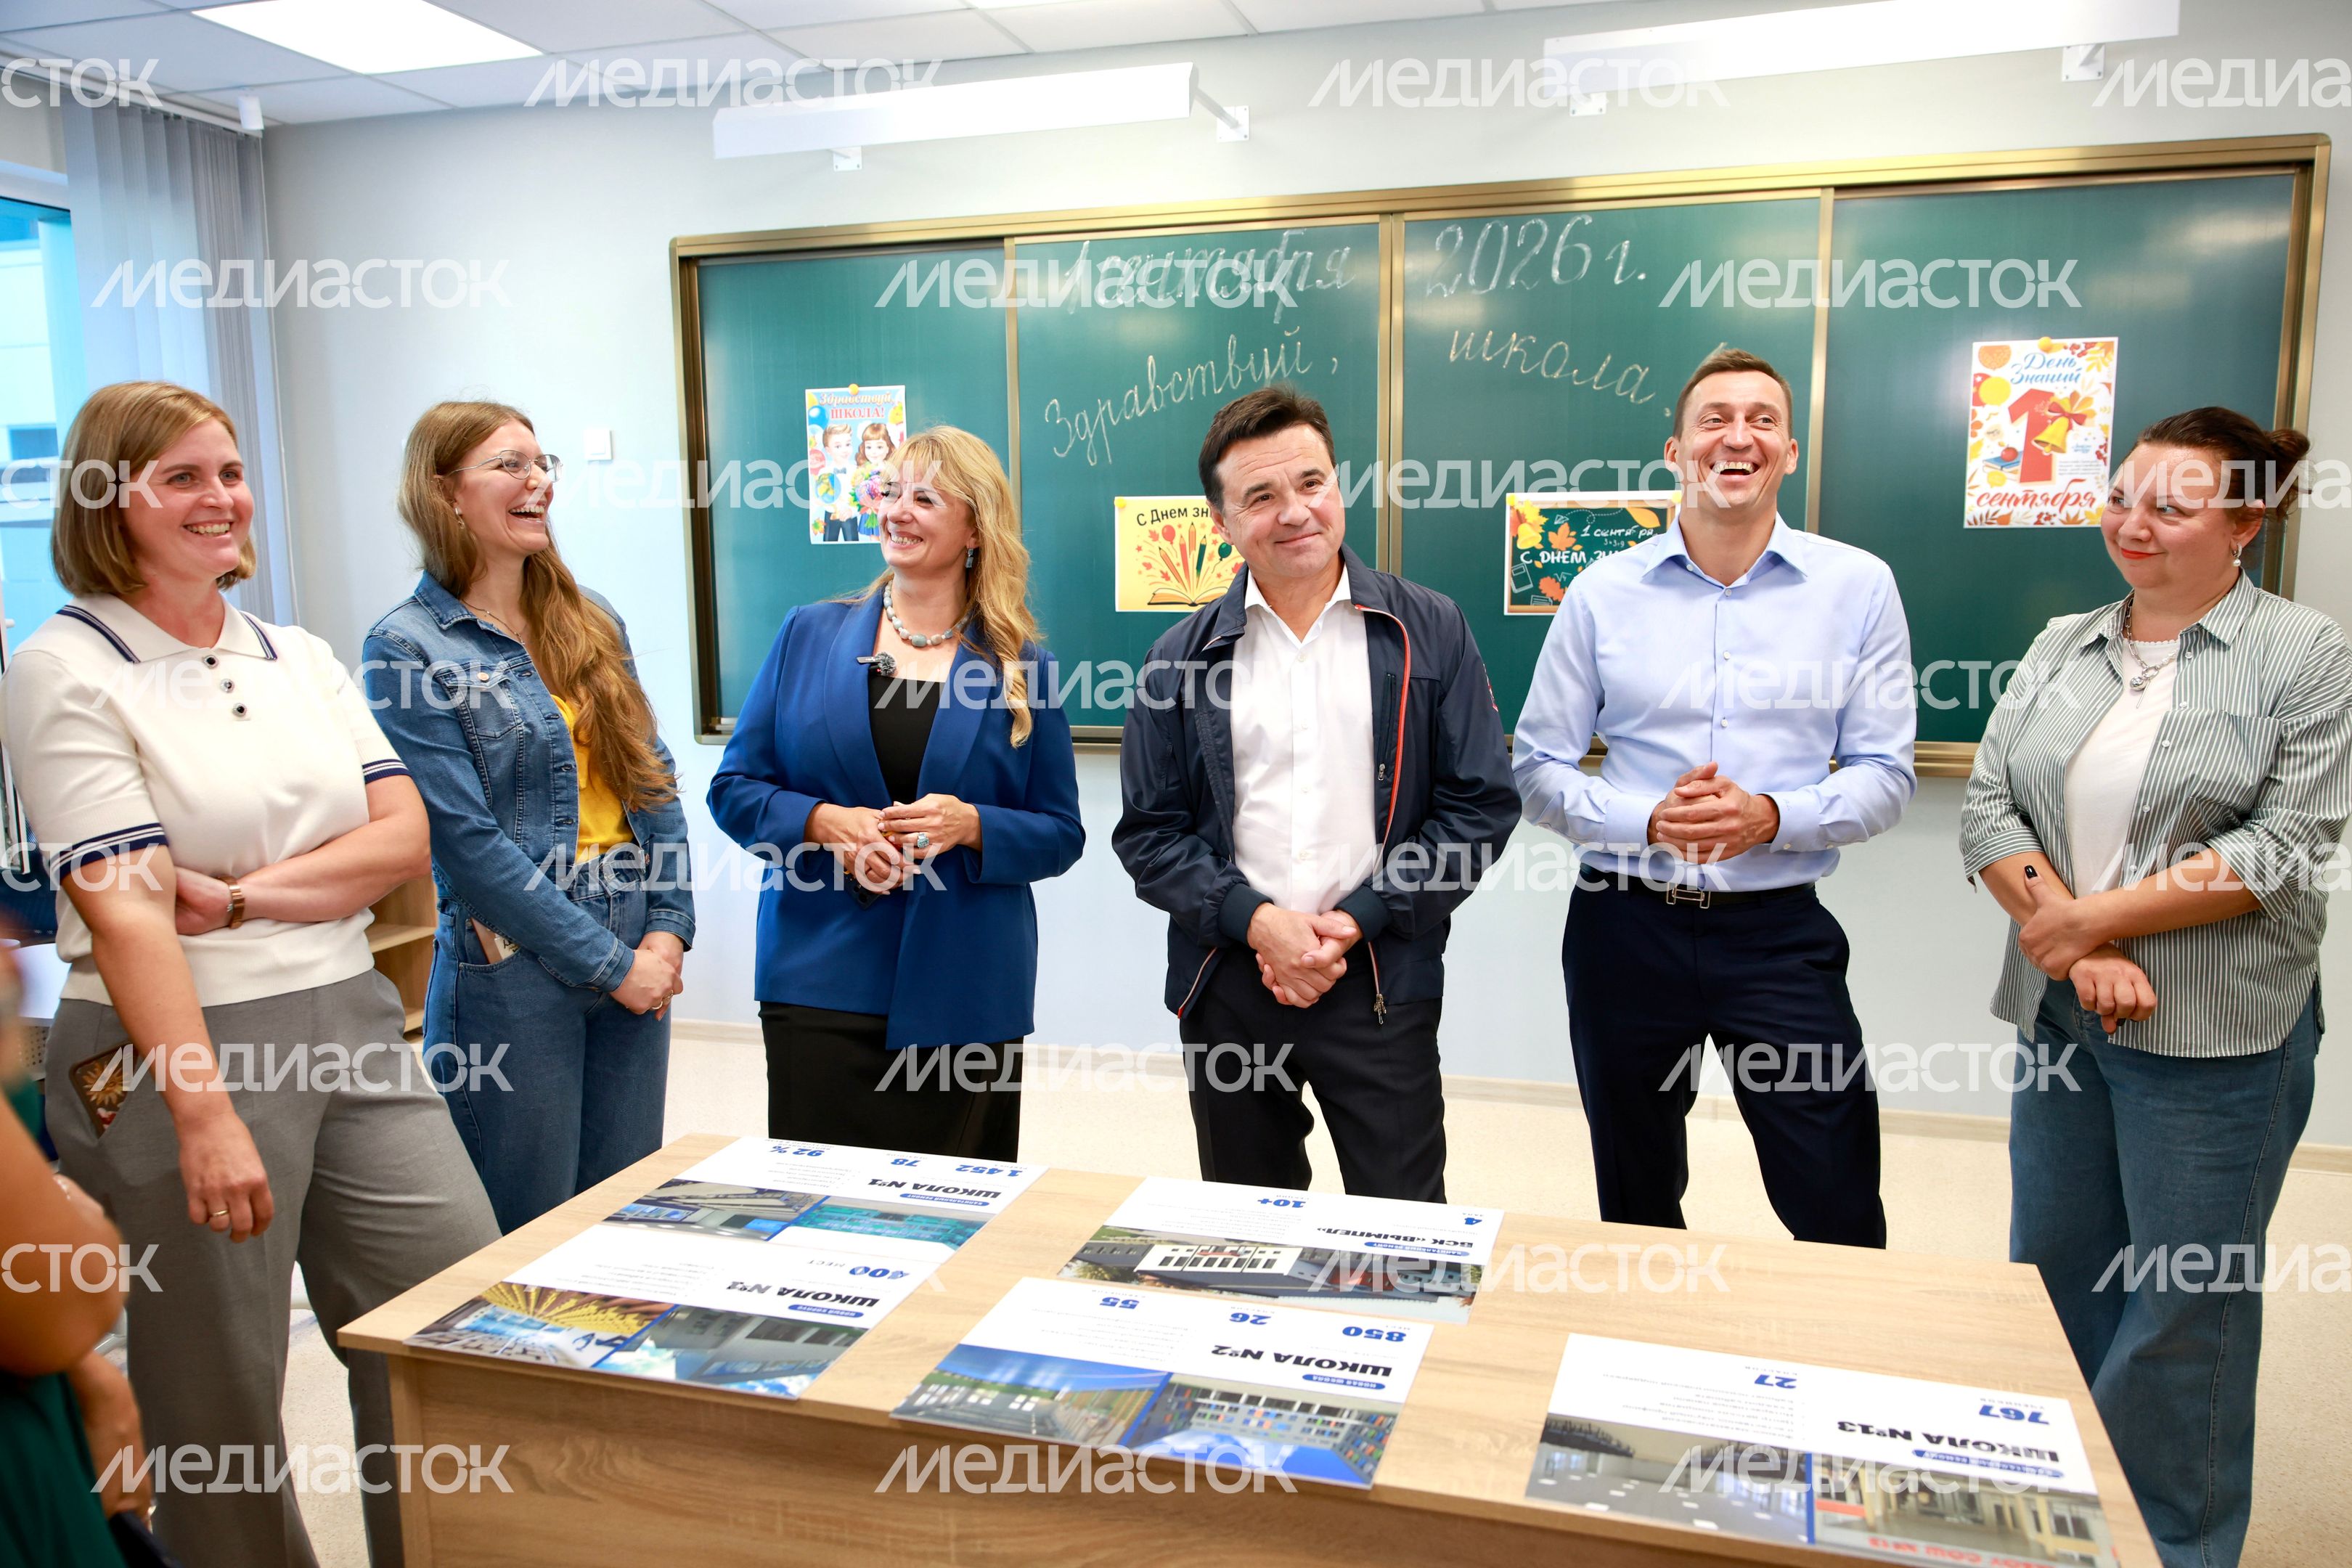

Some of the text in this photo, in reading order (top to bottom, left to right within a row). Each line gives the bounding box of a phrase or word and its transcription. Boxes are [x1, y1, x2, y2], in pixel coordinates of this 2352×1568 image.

[1064, 240, 1090, 314] 1
[1426, 213, 1593, 298] 2026
[1605, 240, 1647, 285] г.
[2024, 352, 2077, 370] День
[2010, 363, 2083, 385] Знаний
[830, 407, 885, 420] ШКОЛА!
[2008, 388, 2055, 483] 1
[1976, 478, 2096, 514] сентября
[1136, 507, 1212, 526] С Днем зн
[1580, 525, 1591, 537] 1
[1520, 550, 1621, 565] С ДНЕМ ЗН
[792, 1148, 825, 1157] 92
[890, 1158, 920, 1167] 78
[867, 1178, 907, 1189] №1
[911, 1182, 1003, 1199] ШКОЛА
[1257, 1198, 1306, 1209] 10+
[1463, 1217, 1482, 1226] 4
[1316, 1227, 1426, 1243] «ВЫМПЕЛ»
[848, 1266, 910, 1280] 400
[776, 1286, 880, 1307] ШКОЛА
[1098, 1297, 1140, 1310] 55
[1228, 1312, 1272, 1326] 26
[1342, 1326, 1407, 1343] 850
[1210, 1345, 1265, 1360] №2
[1273, 1352, 1393, 1377] ШКОЛА
[1754, 1373, 1797, 1390] 27
[1978, 1404, 2050, 1426] 767
[1837, 1421, 2059, 1463] ШКОЛА №13
